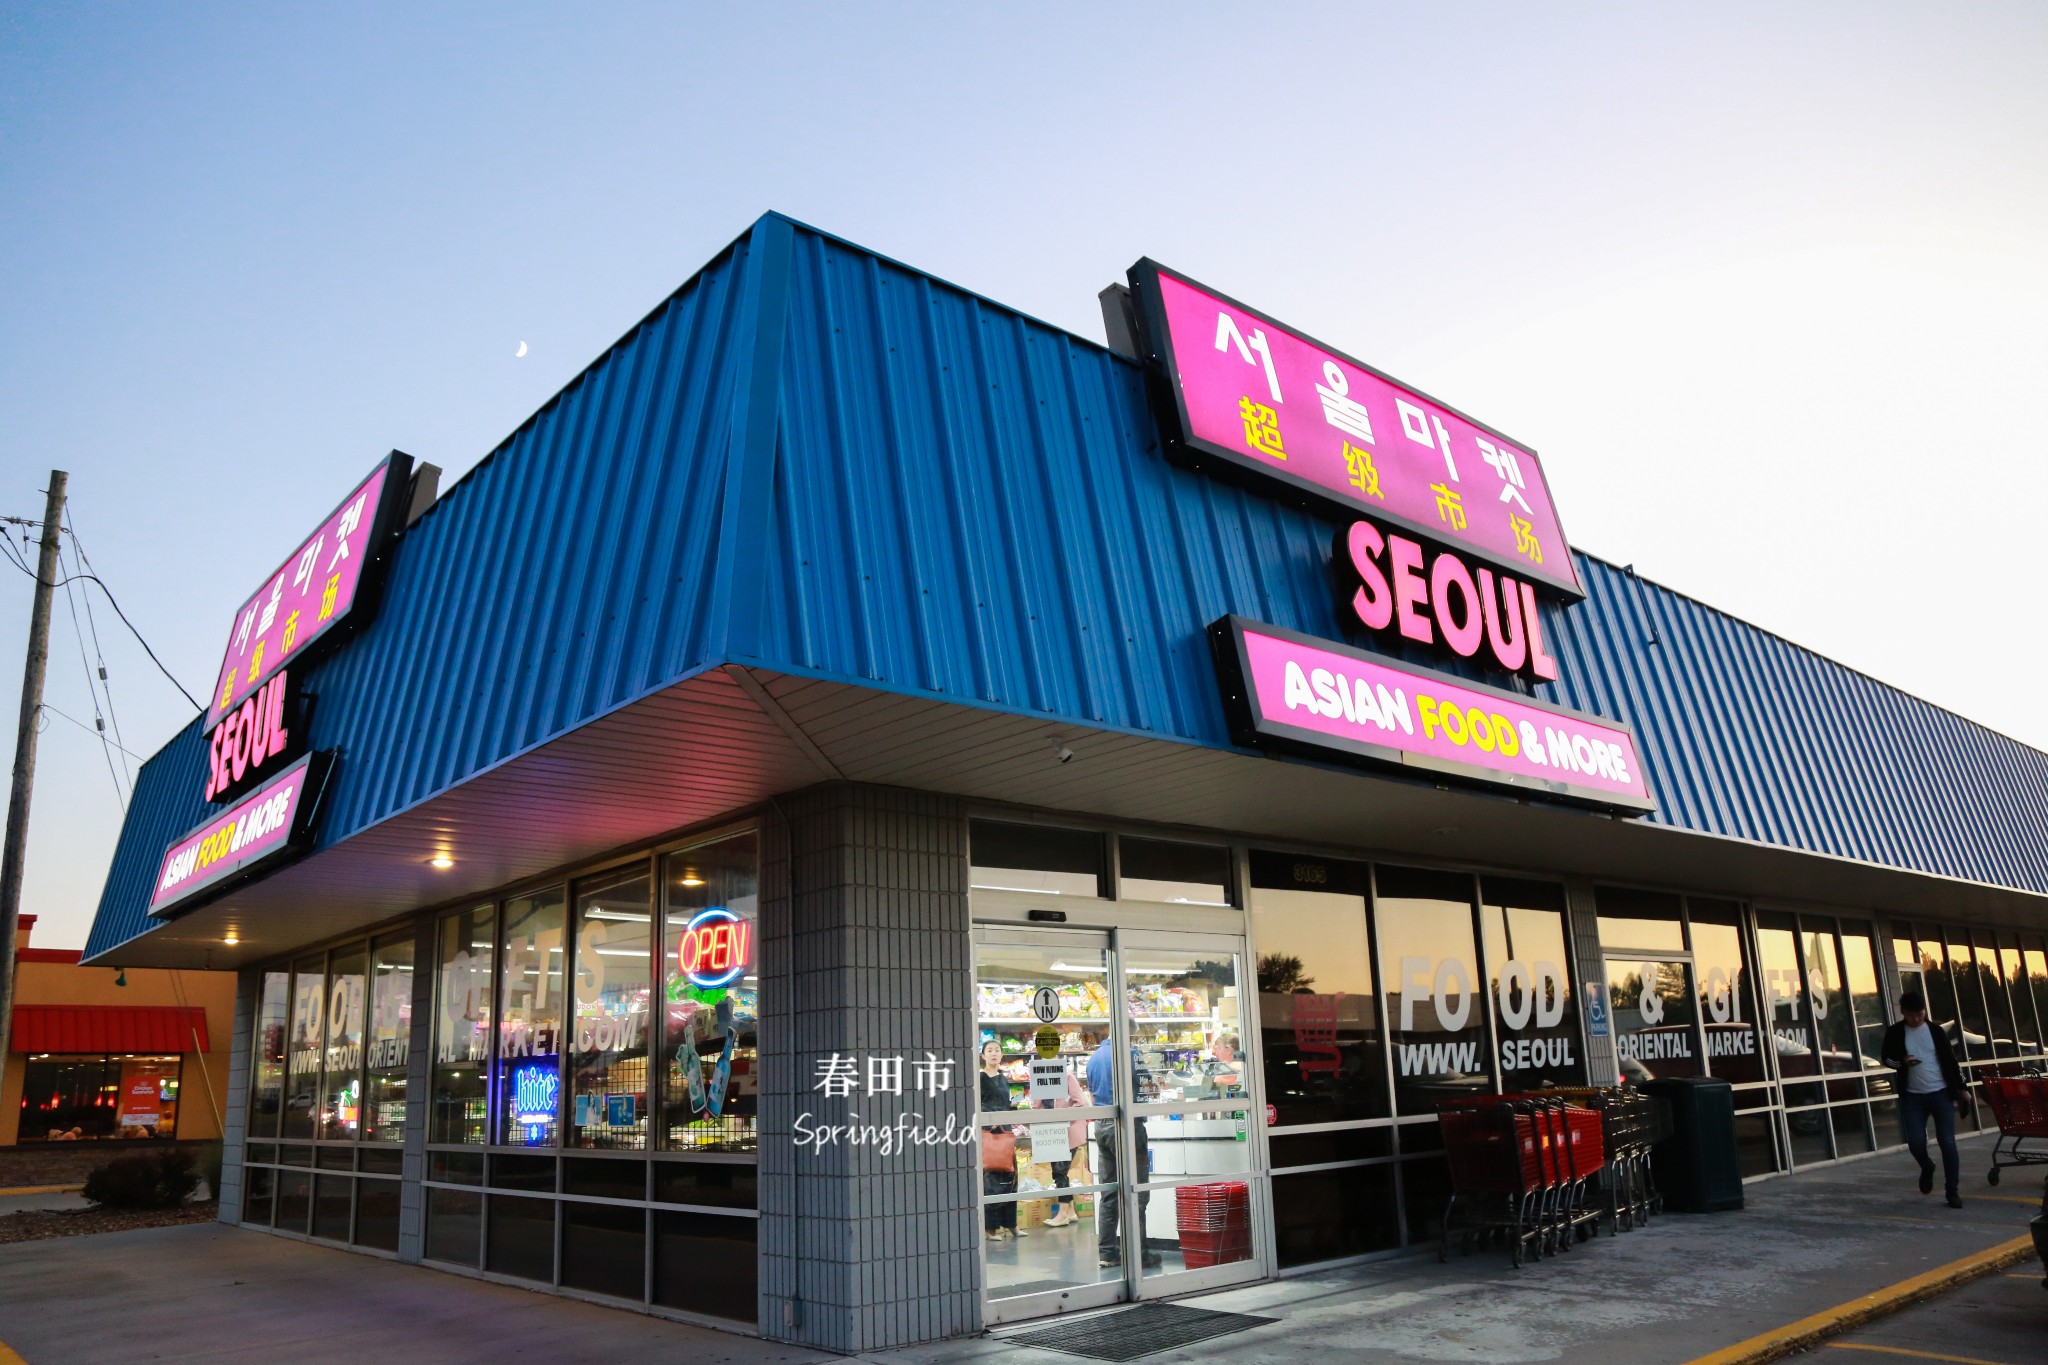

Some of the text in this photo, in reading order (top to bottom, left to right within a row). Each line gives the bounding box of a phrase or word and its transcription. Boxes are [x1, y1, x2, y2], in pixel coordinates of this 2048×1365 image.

[1214, 310, 1534, 515] 서울마켓
[1238, 395, 1543, 565] 超级市场
[235, 492, 367, 657] 서울마켓
[1347, 520, 1556, 682] SEOUL
[218, 571, 341, 711] 超级市场
[205, 669, 288, 803] SEOUL
[1284, 660, 1414, 736] ASIAN
[1416, 694, 1520, 758] FOOD
[160, 842, 201, 892] ASIAN
[194, 822, 236, 871] FOOD
[680, 922, 748, 973] OPEN
[1041, 1006, 1054, 1018] IN
[1639, 961, 1664, 1025] &
[1033, 1065, 1064, 1074] NOW HIRING
[1036, 1038, 1060, 1046] CAUTION
[1400, 1041, 1481, 1076] WWW.
[1502, 1038, 1575, 1070] SEOUL
[1617, 1033, 1692, 1061] ORIENTAL
[1037, 1077, 1061, 1086] FULL TIME
